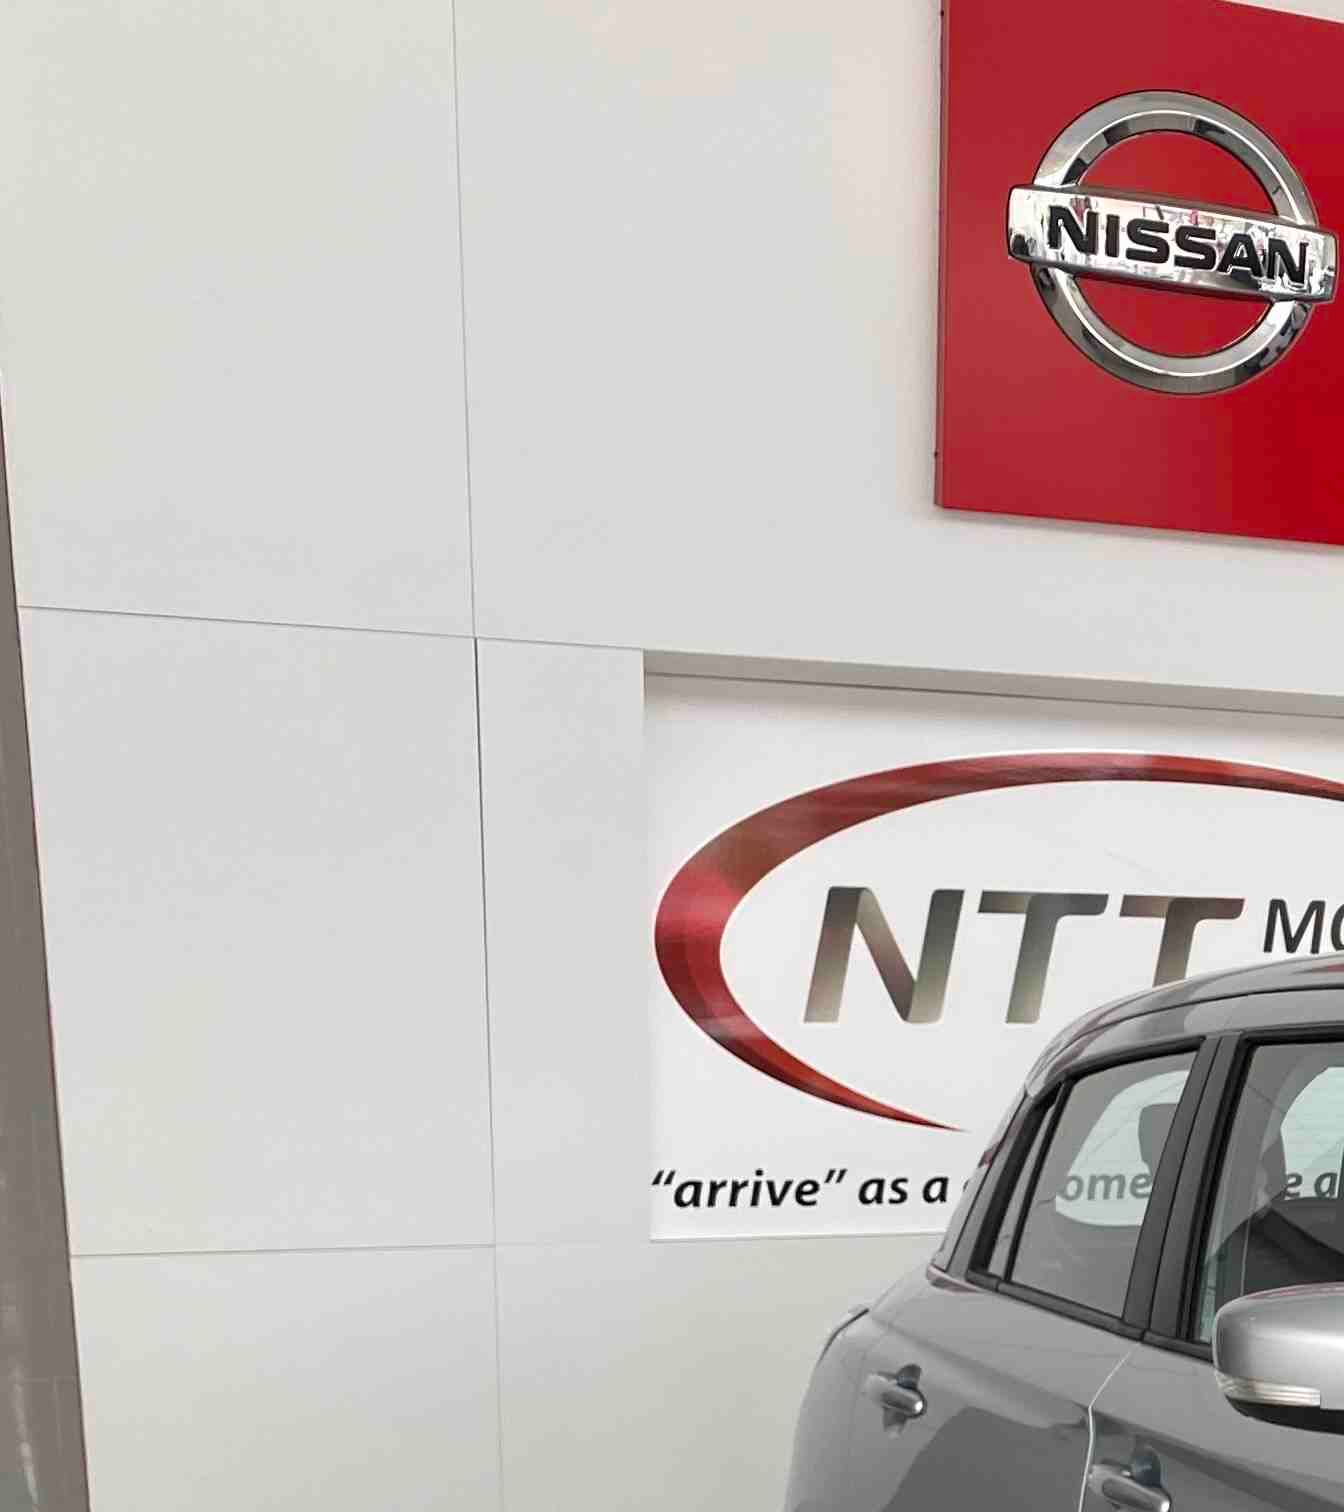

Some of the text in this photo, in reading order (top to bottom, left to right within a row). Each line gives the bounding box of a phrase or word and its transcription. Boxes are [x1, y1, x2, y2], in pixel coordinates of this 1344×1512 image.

[1047, 206, 1309, 284] NISSAN
[803, 886, 1245, 1024] NTT
[858, 1177, 909, 1205] as
[922, 1176, 950, 1204] a
